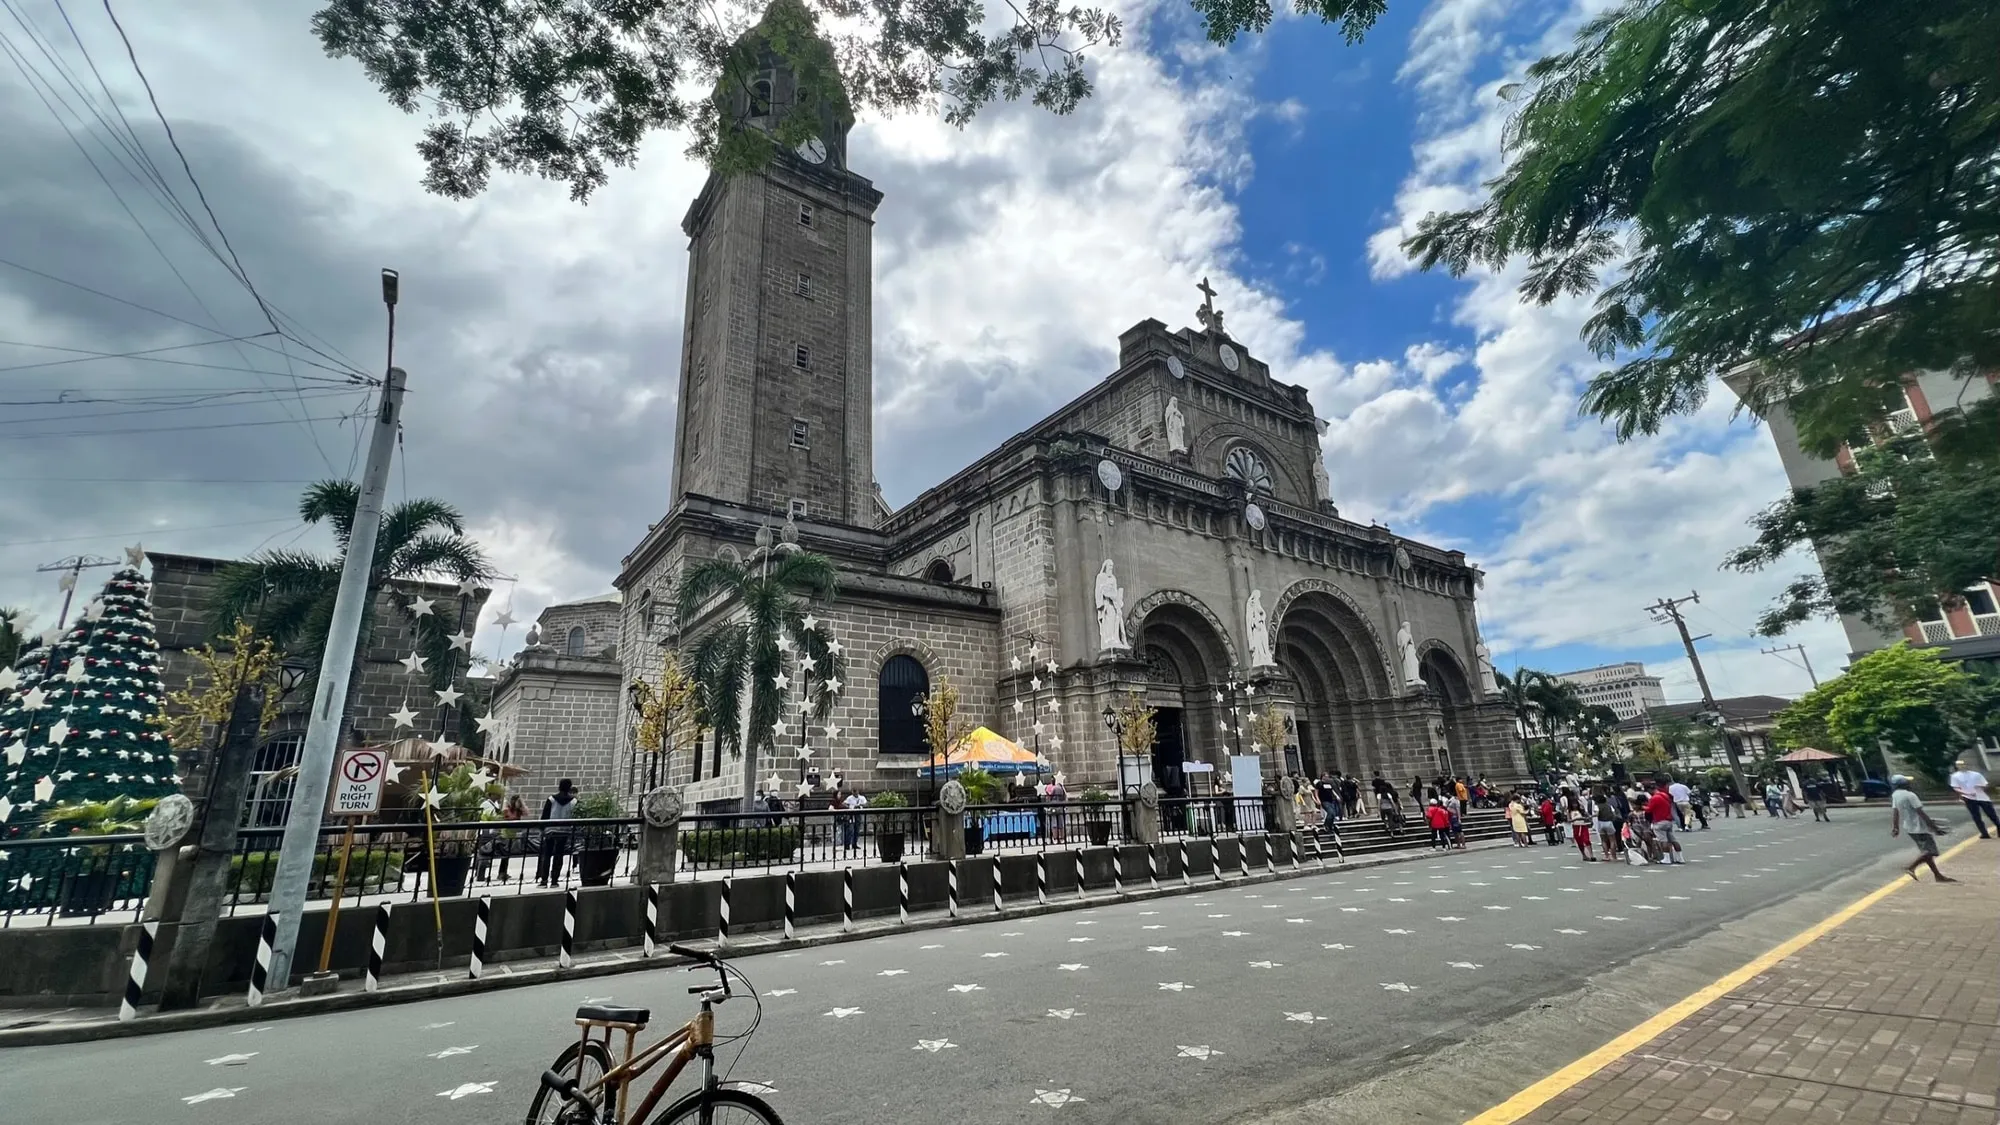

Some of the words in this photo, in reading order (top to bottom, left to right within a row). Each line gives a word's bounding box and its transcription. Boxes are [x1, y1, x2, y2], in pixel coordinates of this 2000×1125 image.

[350, 784, 367, 792] NO
[340, 793, 373, 801] RIGHT
[340, 801, 370, 809] TURN
